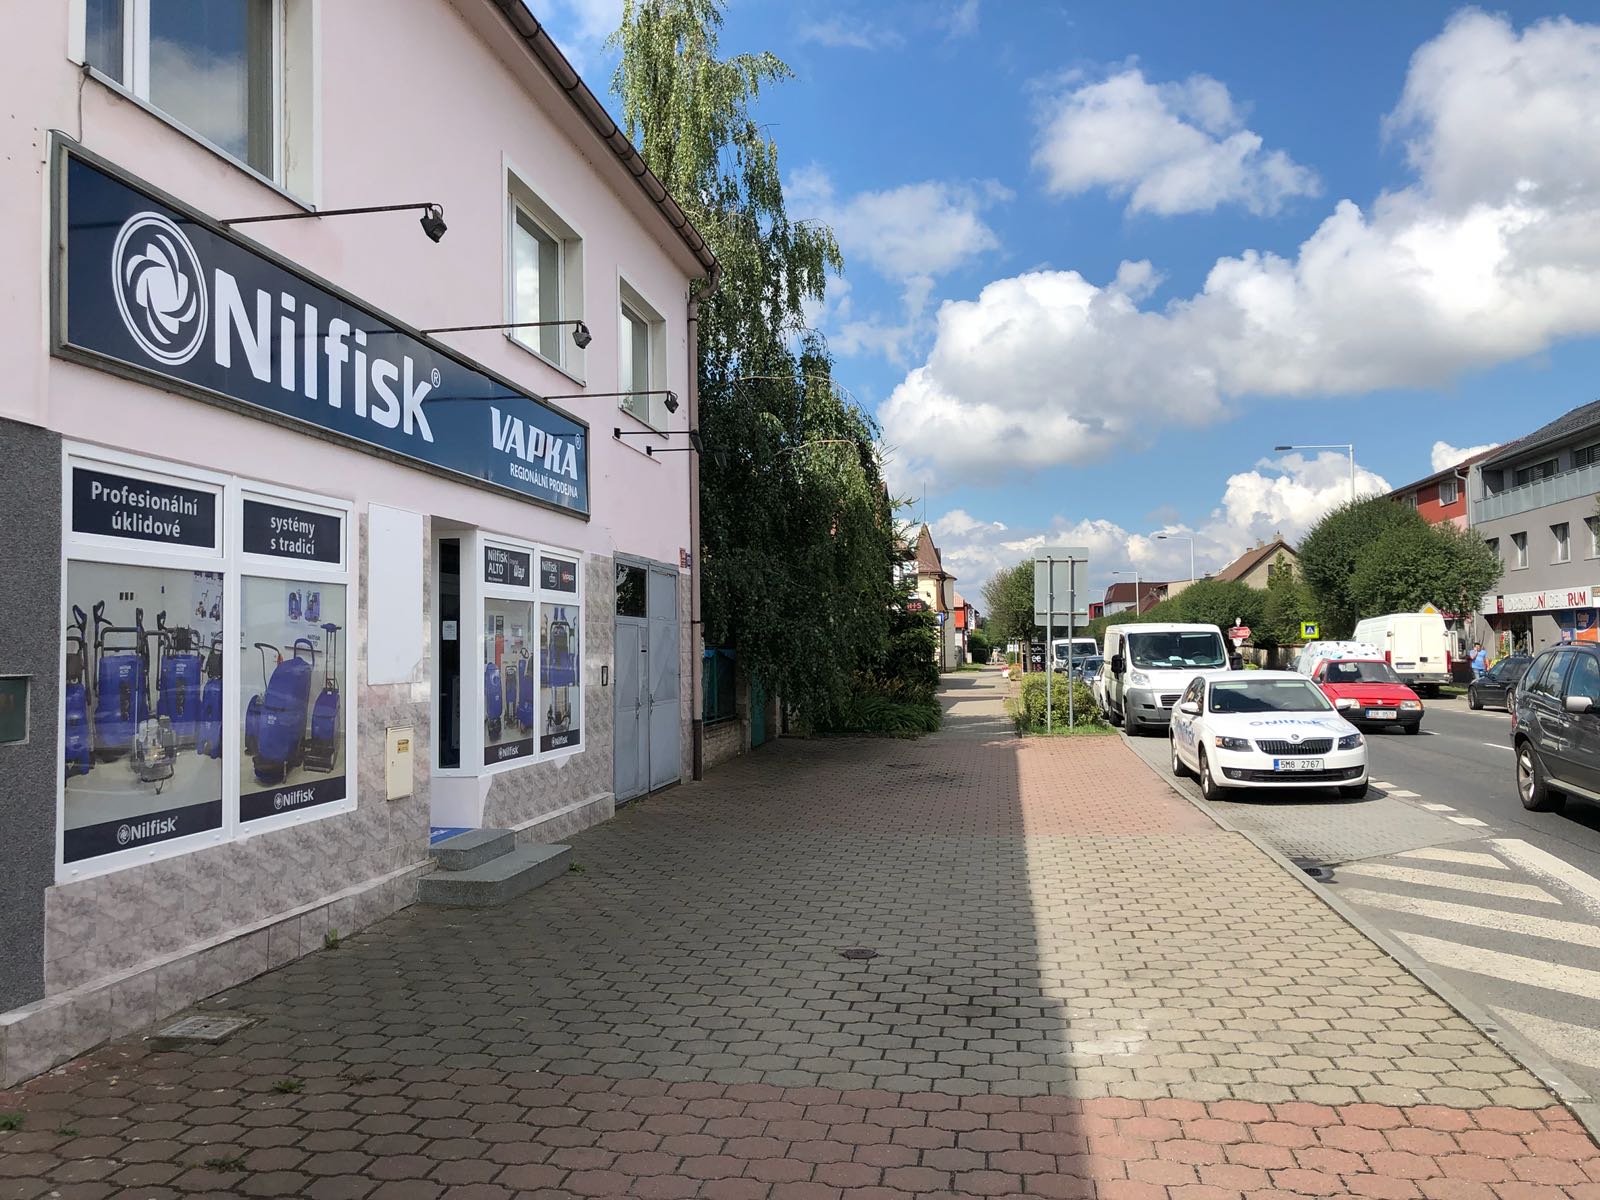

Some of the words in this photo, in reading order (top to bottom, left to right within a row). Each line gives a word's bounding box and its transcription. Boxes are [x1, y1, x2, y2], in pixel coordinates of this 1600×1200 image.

[510, 463, 549, 489] REGIONÁLNÍ
[549, 478, 578, 498] PRODEJNA
[91, 481, 199, 516] Profesionální
[112, 511, 181, 538] úklidové
[270, 515, 315, 538] systémy
[270, 540, 277, 550] s
[279, 537, 315, 555] tradicí
[488, 549, 508, 564] Nilfisk
[488, 563, 504, 575] ALTO
[542, 560, 557, 573] Nilfisk
[555, 736, 568, 745] Nilfisk
[502, 746, 519, 757] Nilfisk
[1281, 761, 1296, 769] 5M8
[1301, 760, 1320, 769] 2767
[283, 789, 314, 807] Nilfisk
[131, 816, 176, 841] Nilfisk
